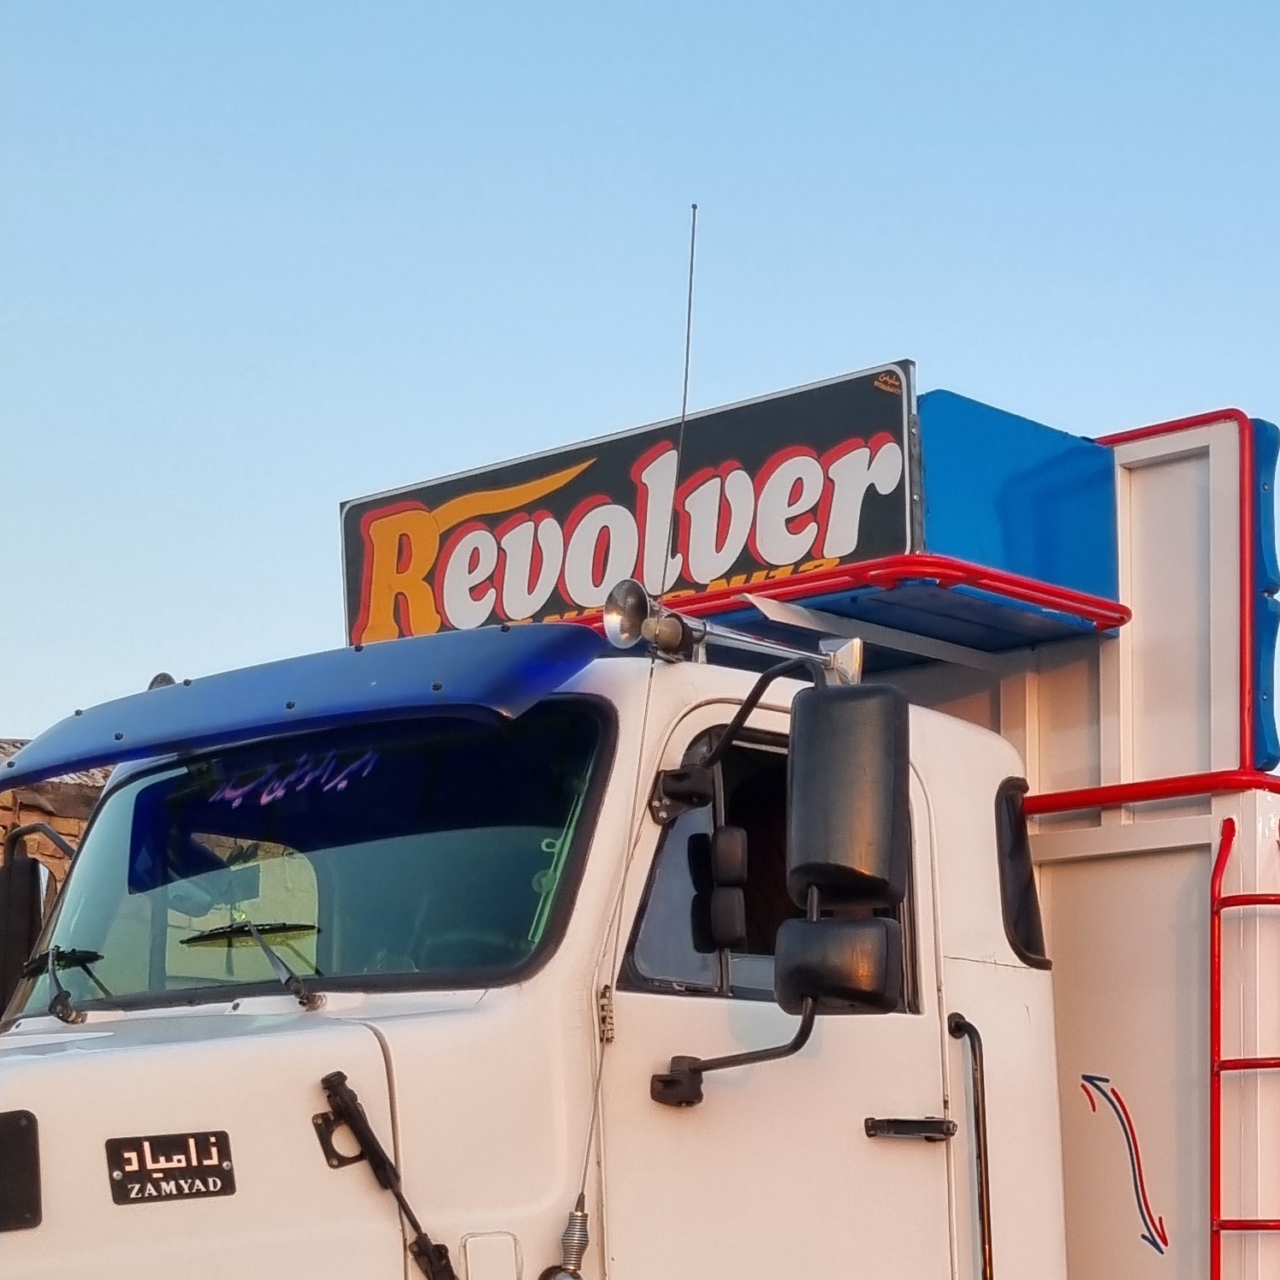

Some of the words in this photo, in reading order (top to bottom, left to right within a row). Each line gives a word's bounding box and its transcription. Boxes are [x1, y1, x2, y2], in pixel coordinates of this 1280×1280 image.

[352, 433, 904, 646] Revolver
[123, 1136, 220, 1178] زامیاد
[127, 1177, 222, 1199] ZAMYAD
